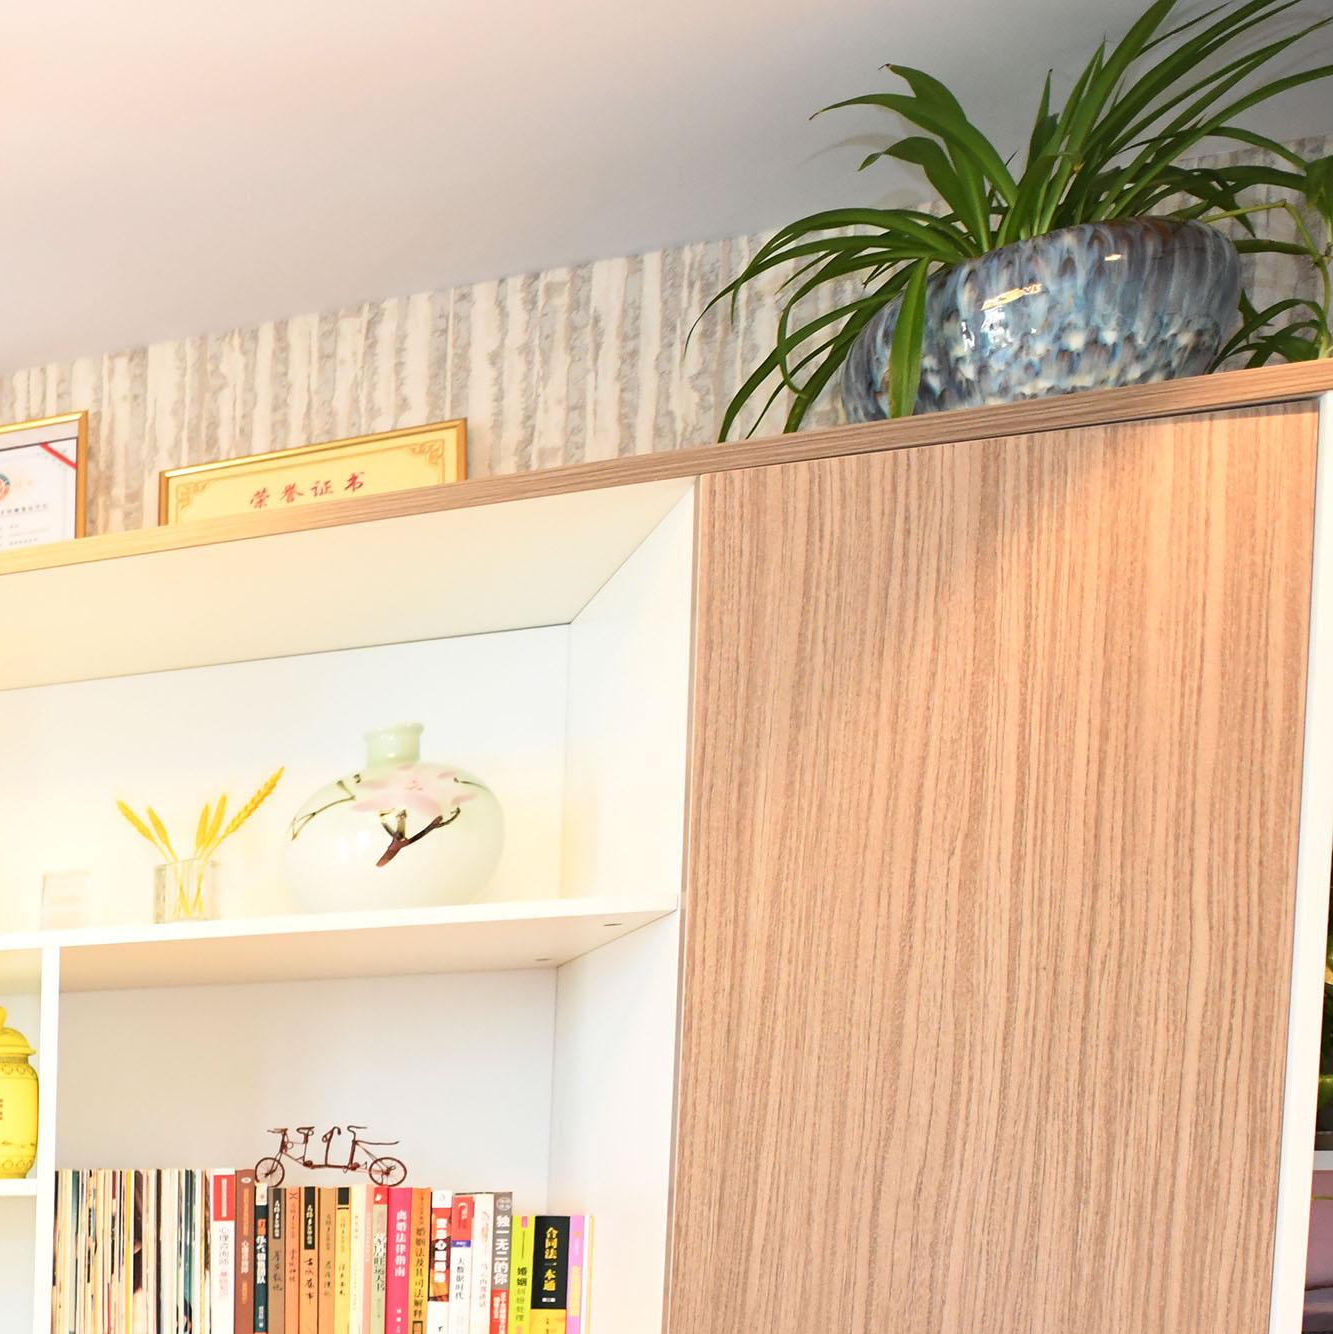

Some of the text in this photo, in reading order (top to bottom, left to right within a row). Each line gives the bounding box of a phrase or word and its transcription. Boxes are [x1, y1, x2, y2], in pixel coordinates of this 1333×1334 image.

[250, 471, 365, 509] 荣誉证书
[394, 1209, 407, 1278] 离婚法律指南
[413, 1227, 426, 1318] 婚姻法及其司法解释
[493, 1215, 510, 1286] 独一无二的你
[542, 1226, 559, 1292] 合同法一本通
